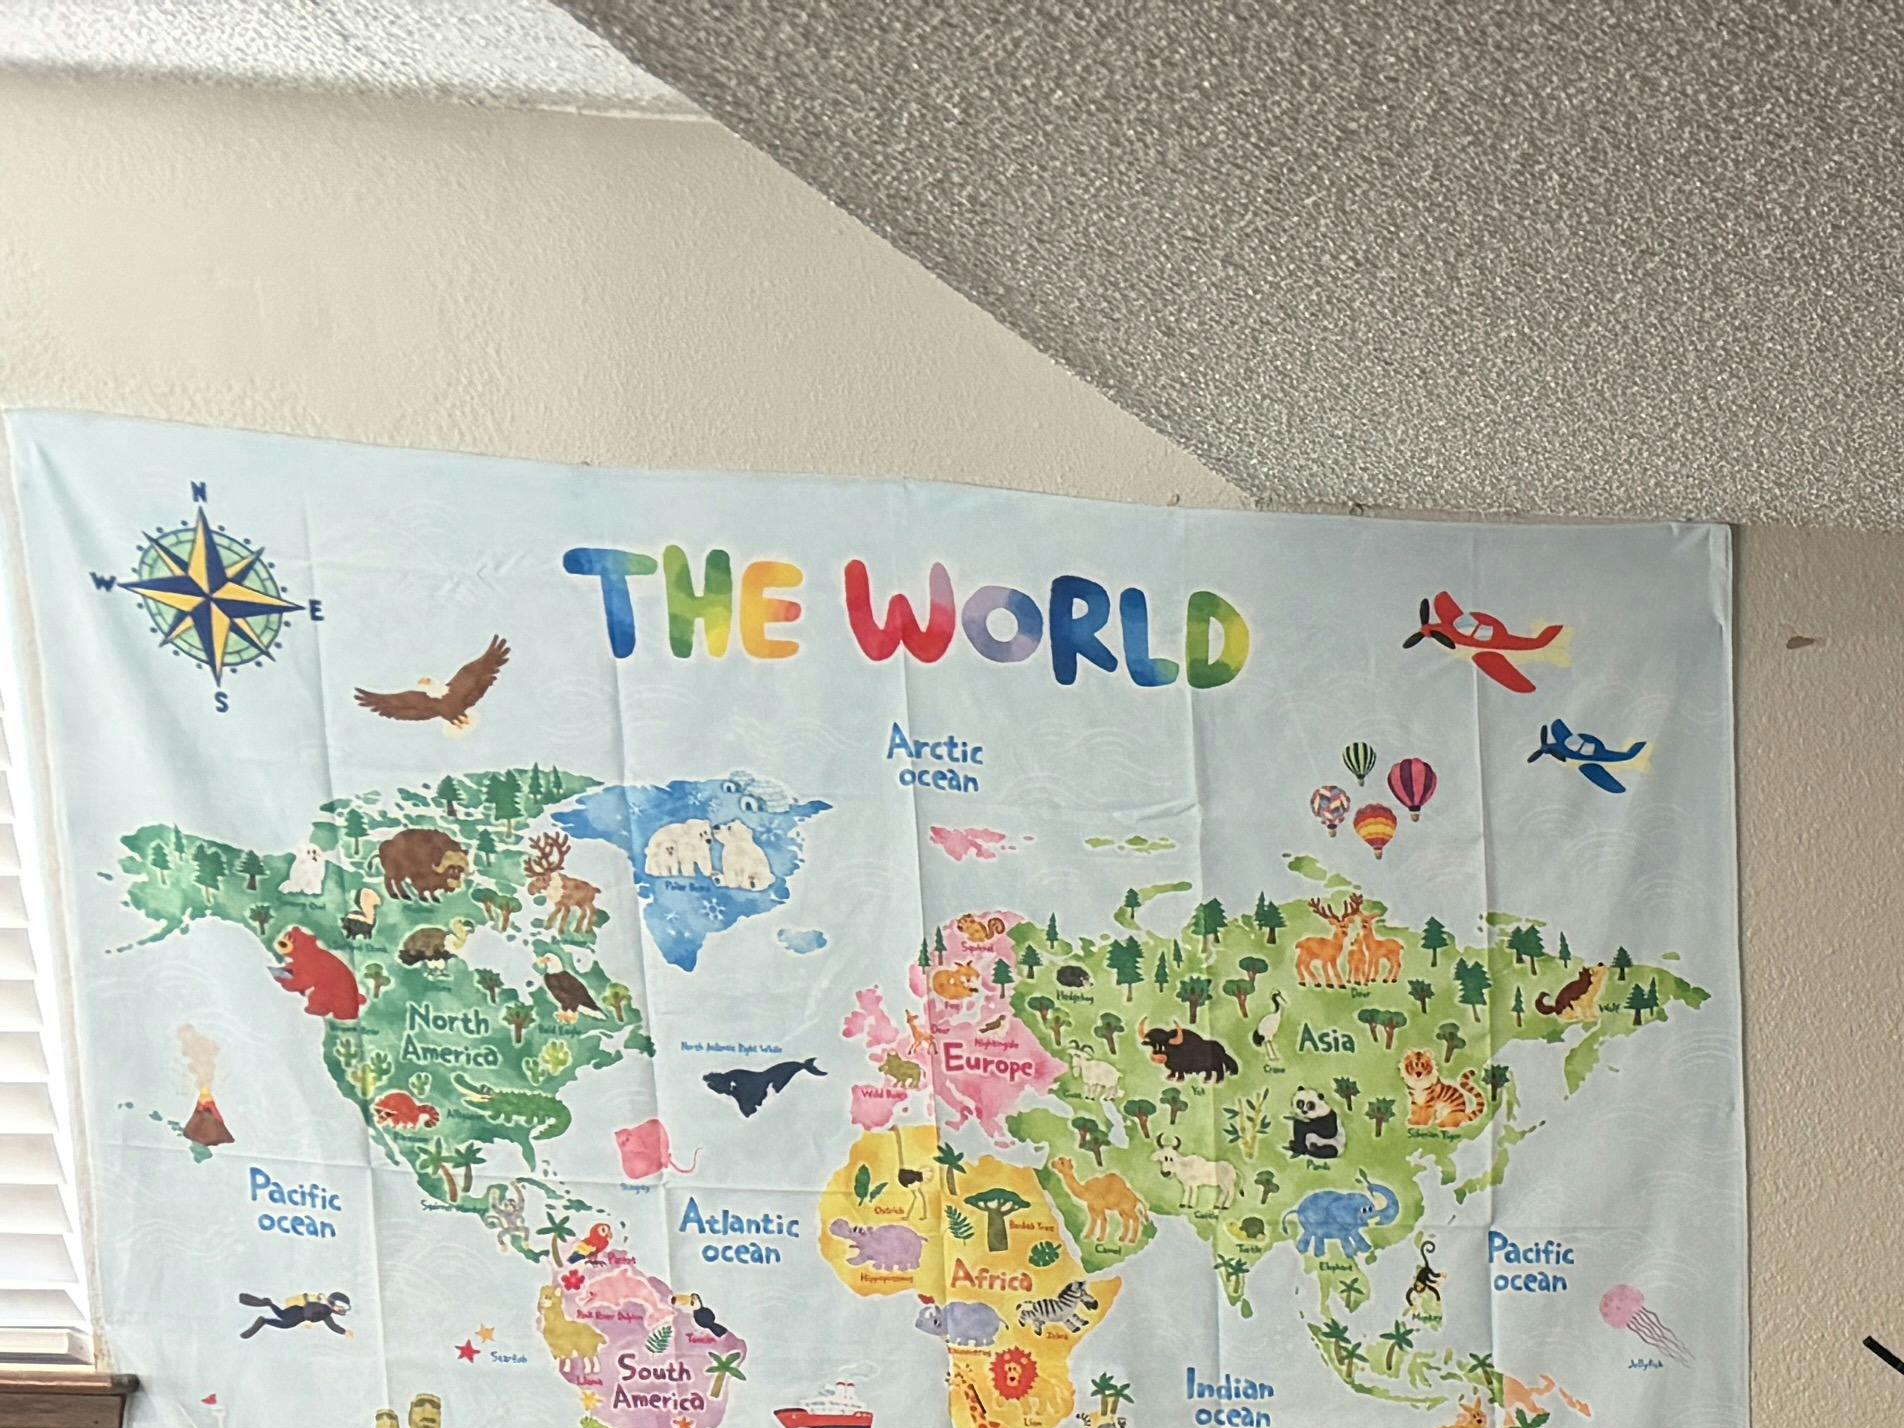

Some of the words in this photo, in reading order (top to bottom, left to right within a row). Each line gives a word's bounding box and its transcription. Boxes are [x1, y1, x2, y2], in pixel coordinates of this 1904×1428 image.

[191, 482, 209, 504] N
[90, 570, 118, 594] W
[309, 599, 325, 623] E
[562, 542, 804, 661] THE
[844, 558, 1251, 690] WORLD
[214, 690, 230, 715] S
[886, 721, 985, 767] Arctic
[897, 765, 981, 795] ocean
[408, 1002, 491, 1036] North
[401, 1033, 500, 1068] America
[1299, 1022, 1356, 1054] Asia
[943, 1041, 1034, 1081] Europe
[248, 1166, 342, 1213] Pacific
[257, 1213, 337, 1241] ocean
[678, 1196, 801, 1241] Atlantic
[701, 1239, 782, 1266] ocean
[1487, 1230, 1575, 1266] Pacific
[950, 1257, 1034, 1293] Africa
[1493, 1271, 1568, 1293] ocean
[617, 1353, 692, 1383] South
[612, 1384, 706, 1412] America
[1185, 1366, 1276, 1404] Indian
